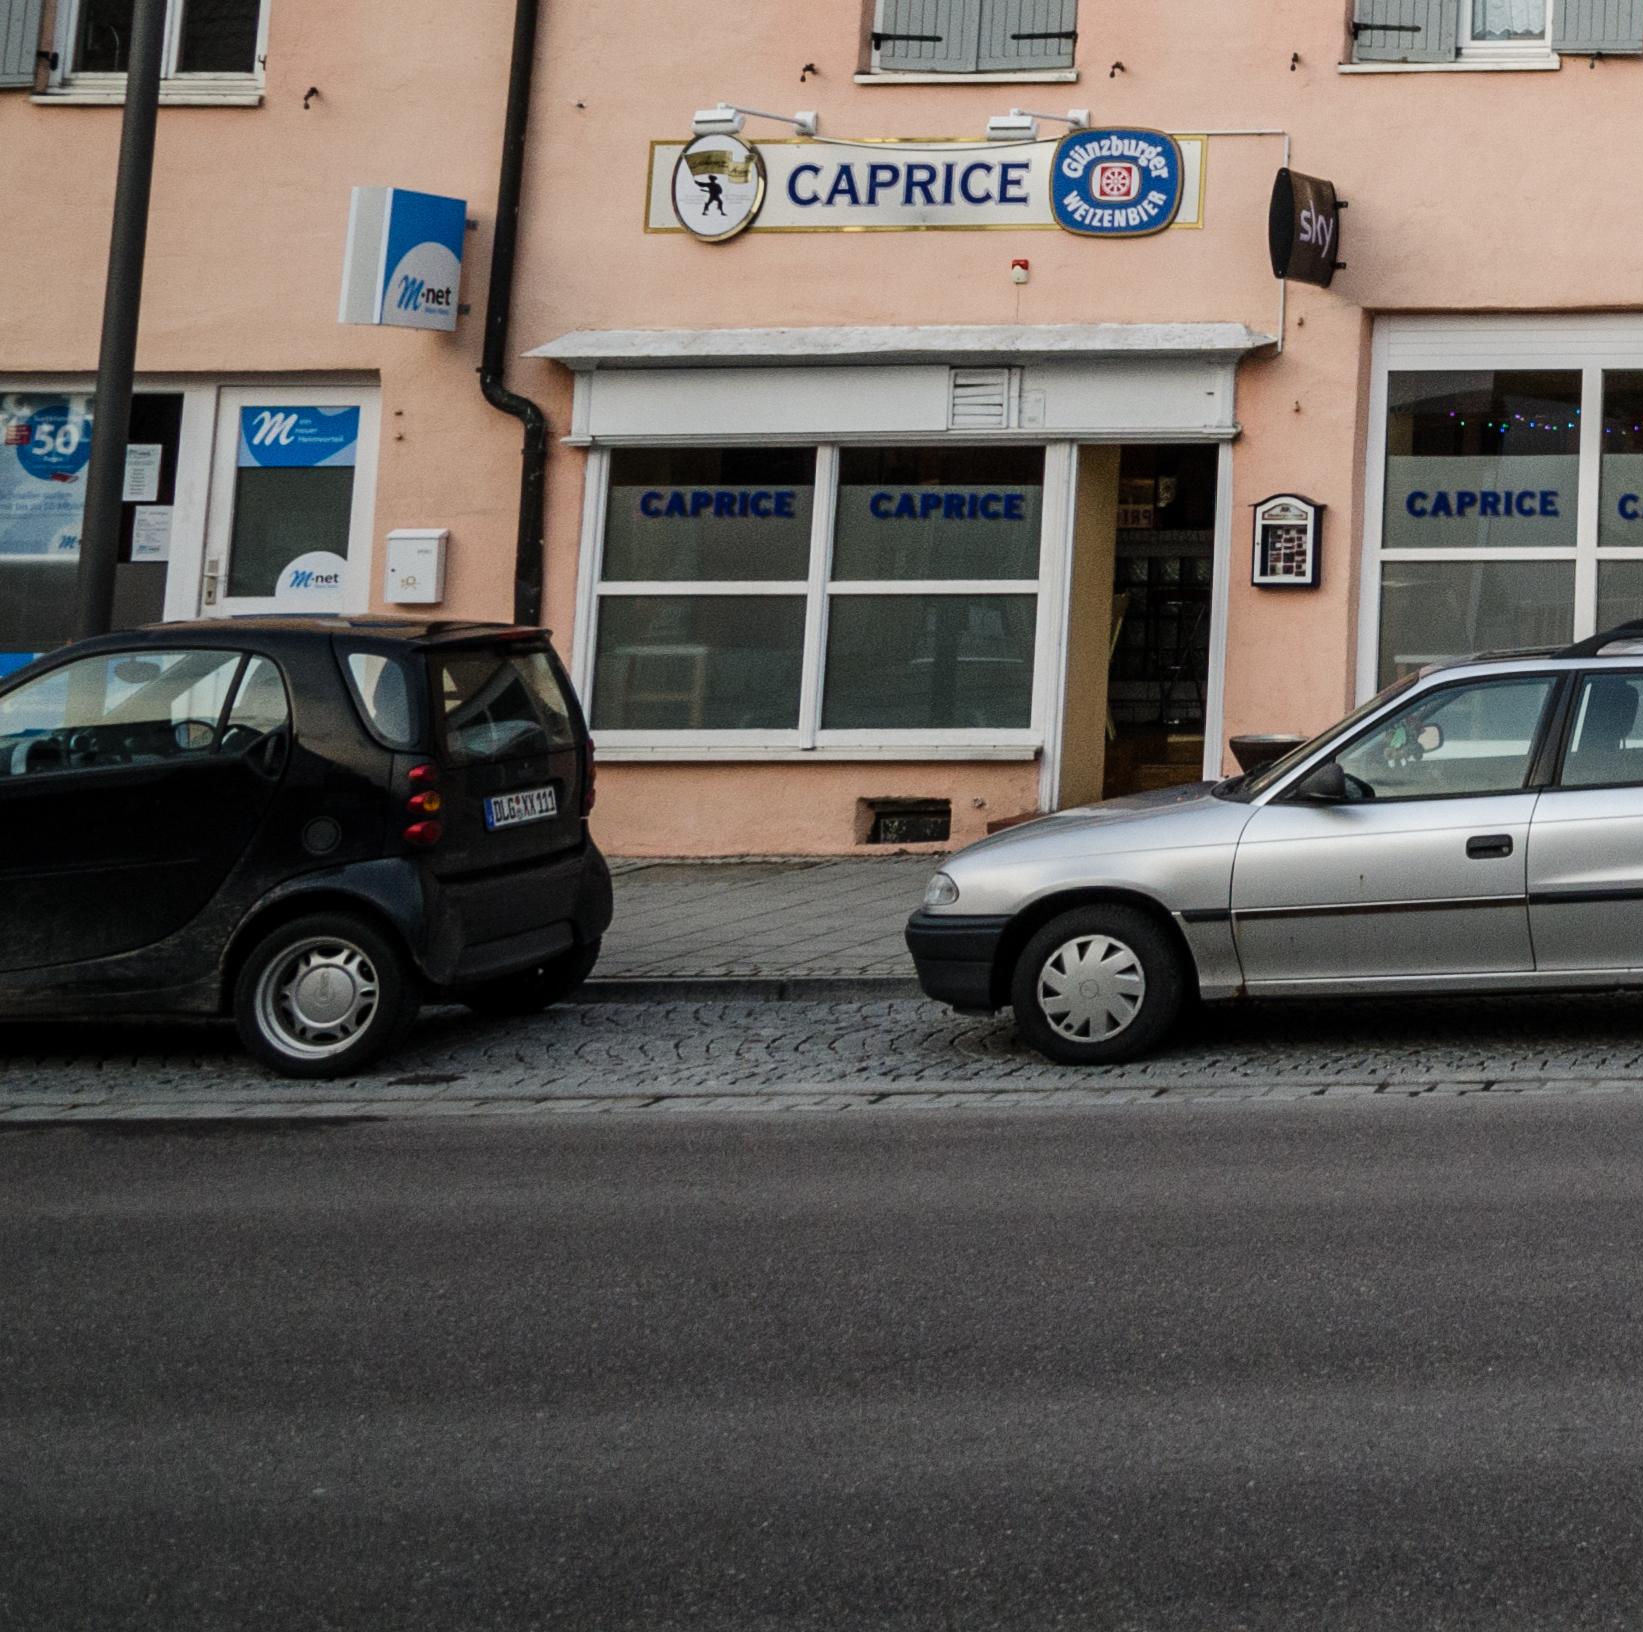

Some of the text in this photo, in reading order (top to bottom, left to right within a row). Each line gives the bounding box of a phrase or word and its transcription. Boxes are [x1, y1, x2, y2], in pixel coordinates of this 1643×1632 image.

[1062, 135, 1169, 179] Günzburger
[786, 159, 1031, 207] CAPRICE
[1063, 190, 1168, 228] WEIZENBIER
[1299, 199, 1334, 258] sky
[32, 423, 80, 456] 50
[640, 490, 796, 518] CAPRICE
[870, 491, 1025, 520] CAPRICE
[1405, 489, 1560, 518] CAPRICE
[493, 790, 555, 822] DLG XX 111
